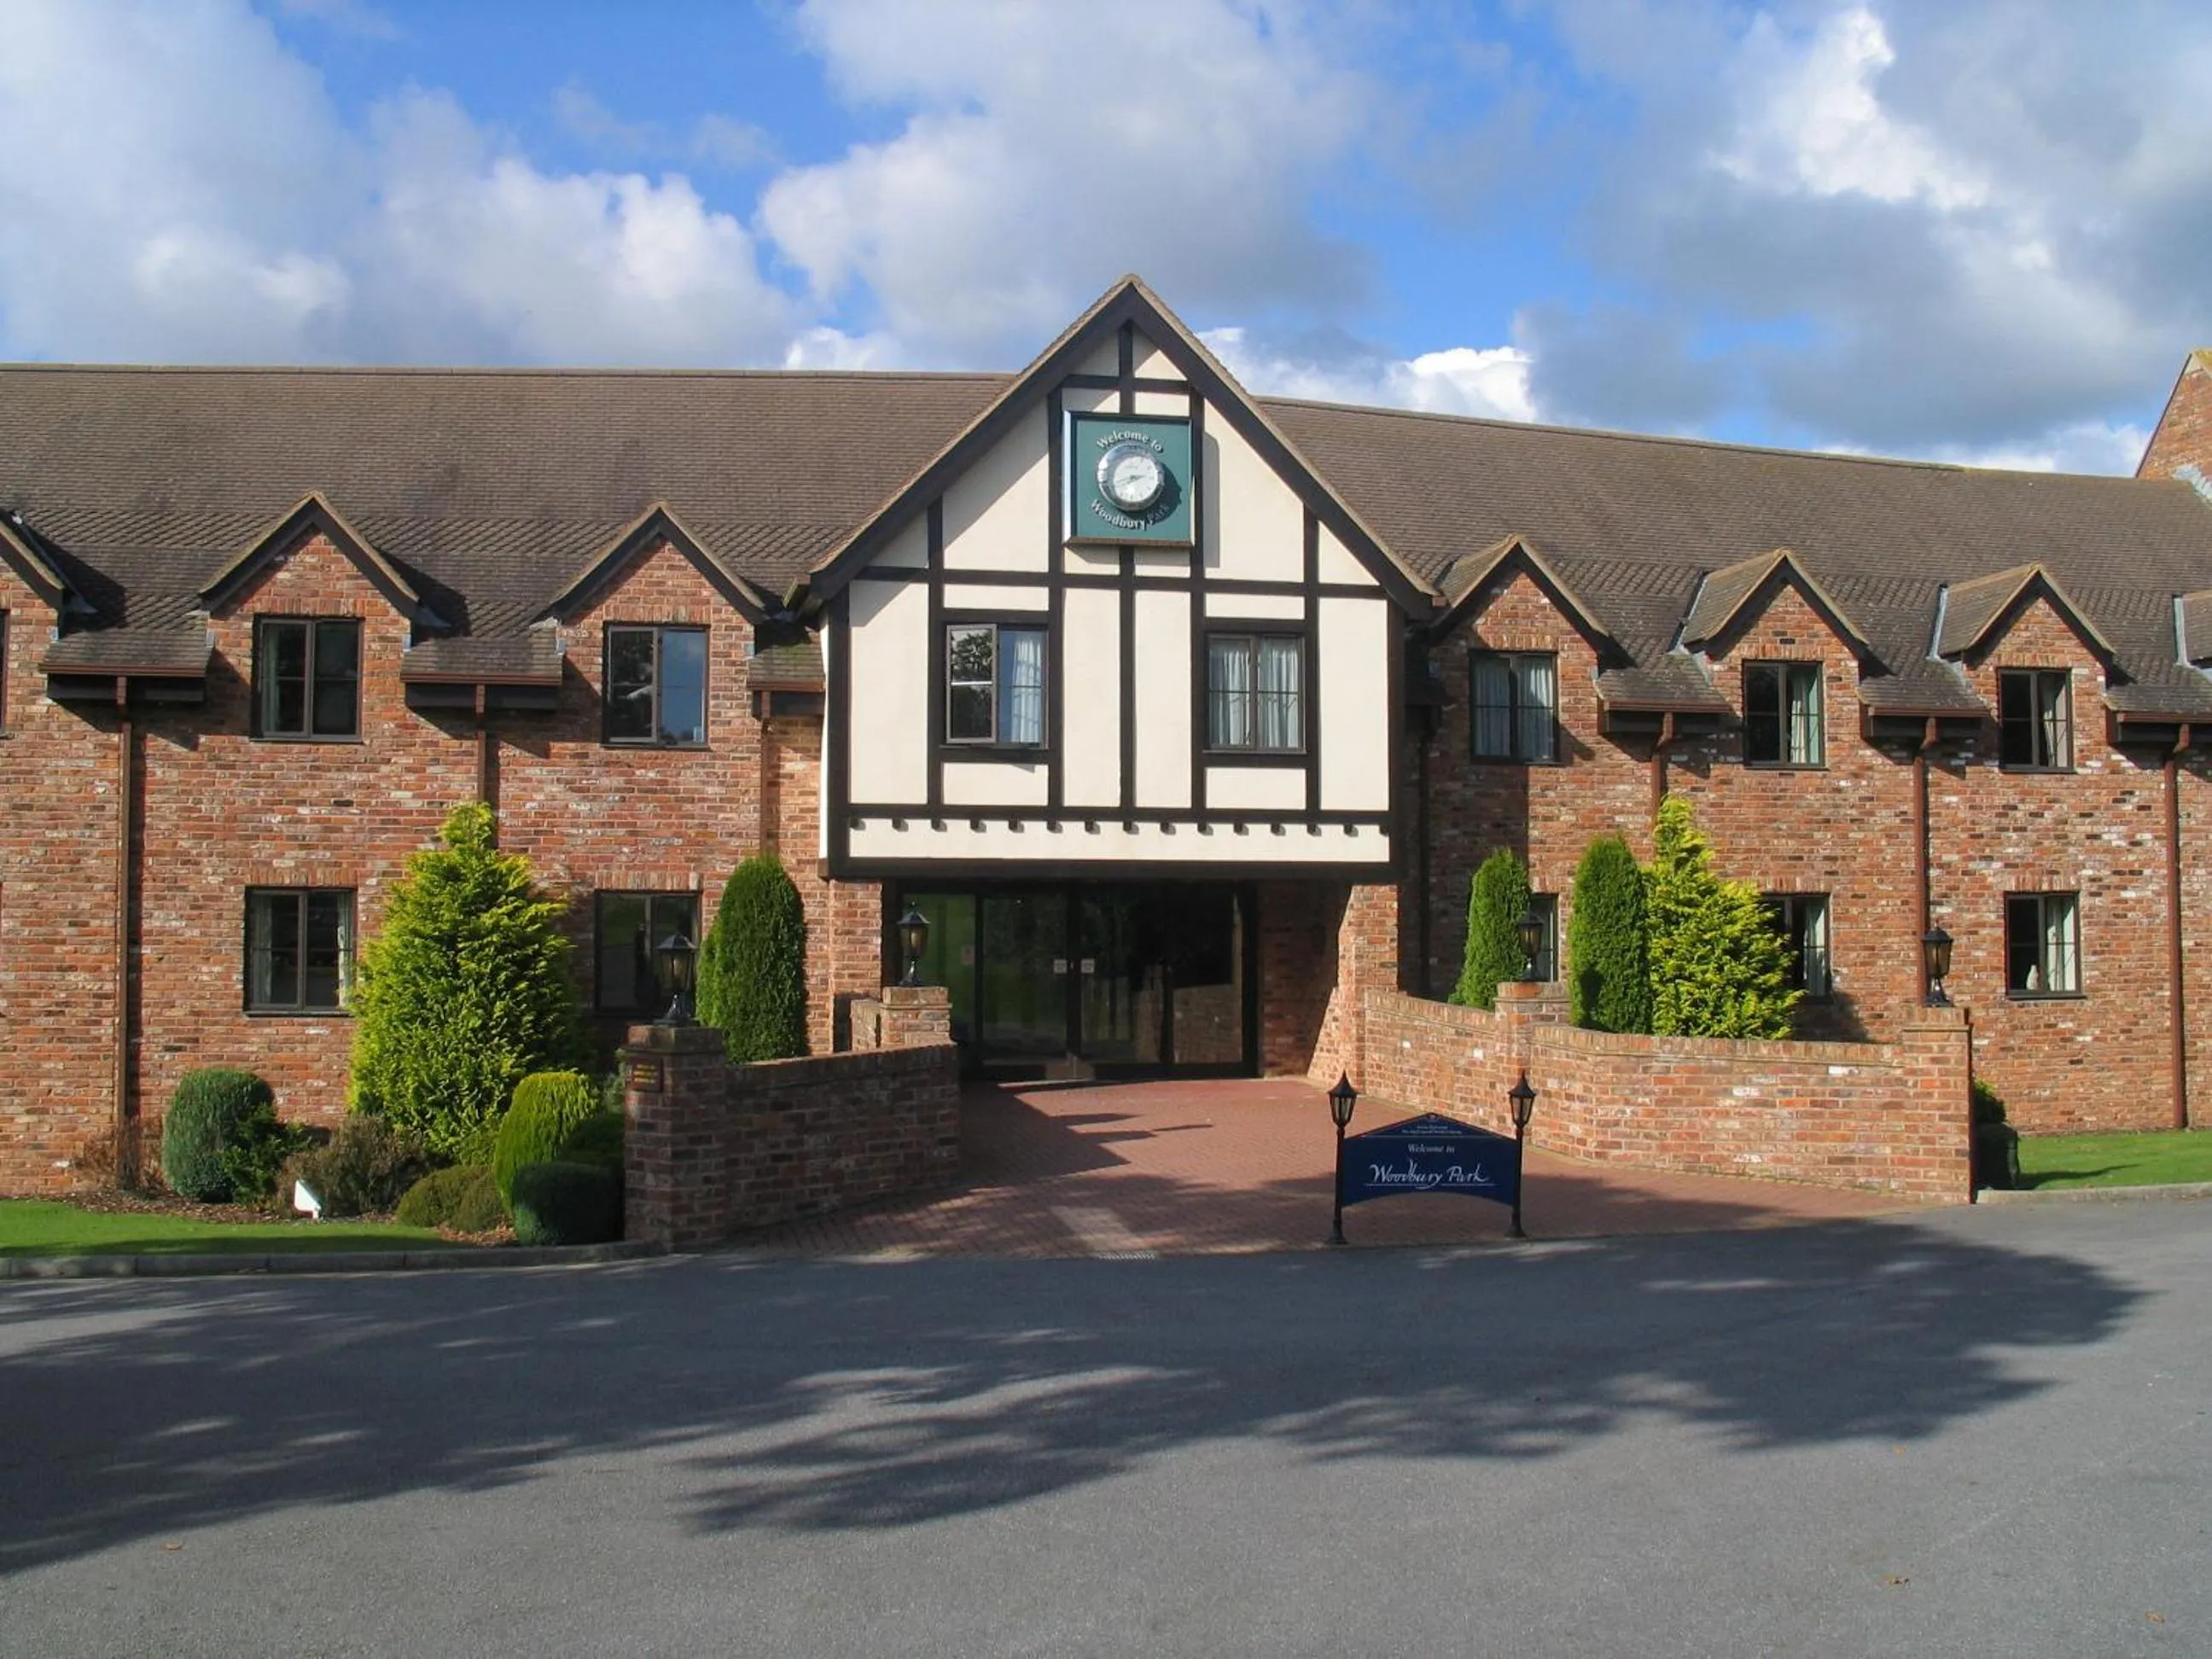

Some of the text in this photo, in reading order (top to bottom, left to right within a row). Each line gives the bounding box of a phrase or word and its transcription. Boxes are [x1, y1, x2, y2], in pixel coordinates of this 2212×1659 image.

[1096, 430, 1162, 451] Welcome to
[1091, 499, 1146, 530] Woodbury
[1407, 1143, 1444, 1153] Welcome
[1369, 1159, 1490, 1190] Woodbury Park
